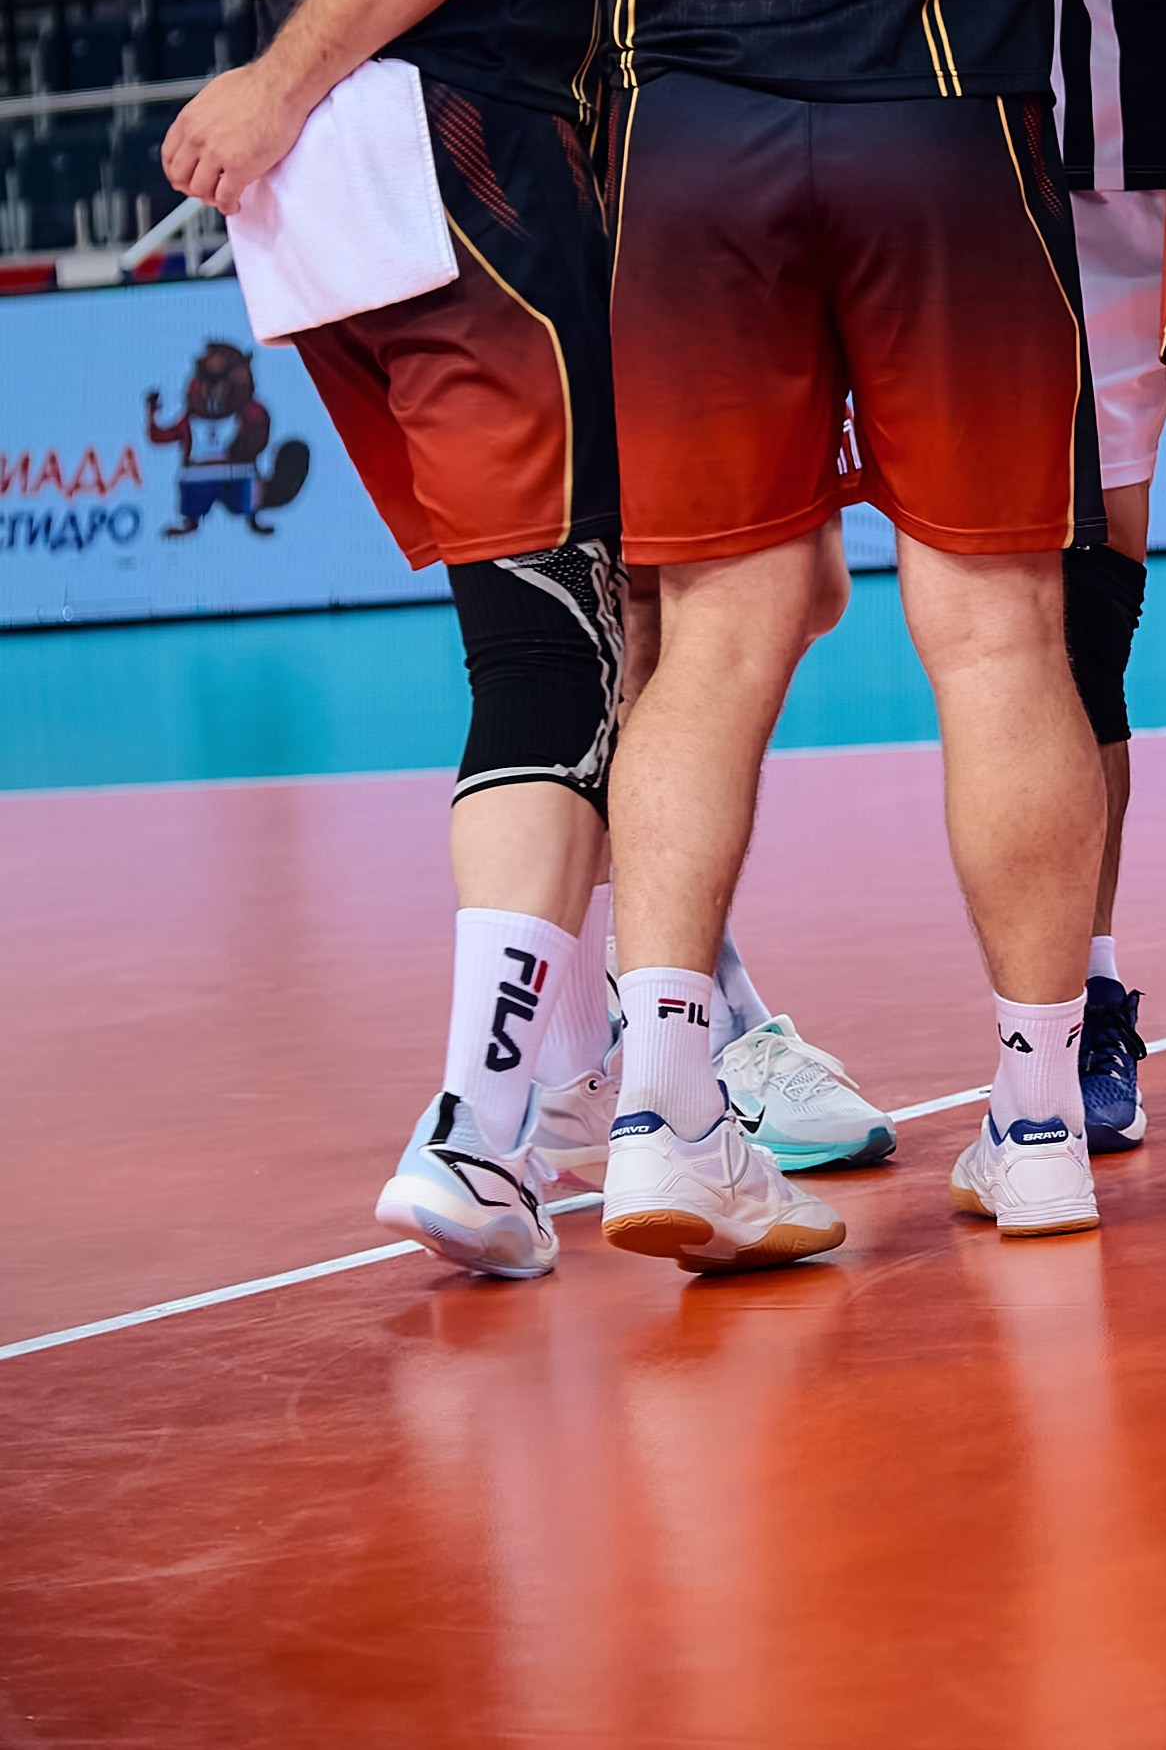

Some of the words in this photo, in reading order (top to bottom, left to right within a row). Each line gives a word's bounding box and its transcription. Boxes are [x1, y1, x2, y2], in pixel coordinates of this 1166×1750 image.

[0, 503, 141, 551] ГИДРО
[485, 946, 549, 1072] FILA
[657, 997, 710, 1029] FIL
[1022, 1130, 1067, 1141] BRAVO
